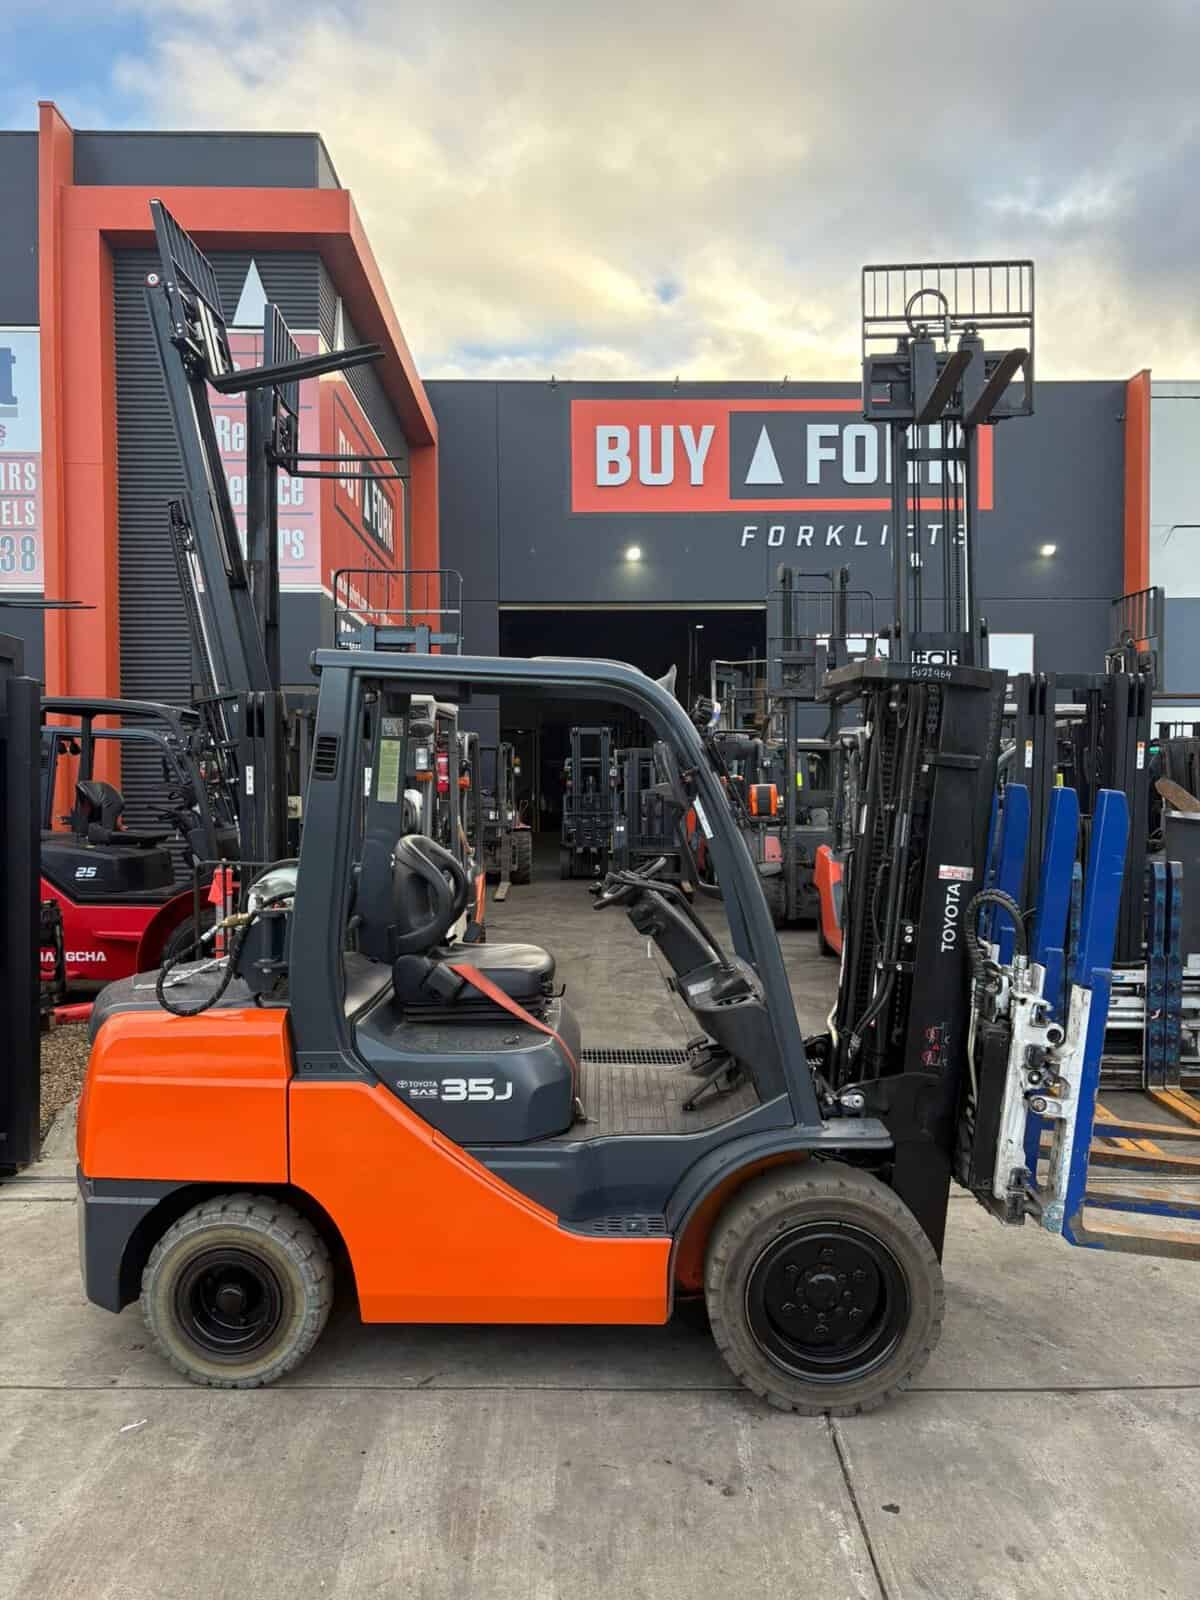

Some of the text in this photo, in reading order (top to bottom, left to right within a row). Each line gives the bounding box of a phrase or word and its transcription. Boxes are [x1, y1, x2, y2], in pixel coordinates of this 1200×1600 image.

[595, 424, 716, 486] BUY
[0, 535, 36, 572] 38
[75, 867, 97, 878] 25
[940, 883, 961, 953] TOYOTA
[408, 1078, 513, 1101] SAS 35J
[409, 1080, 439, 1088] TOYOTA
